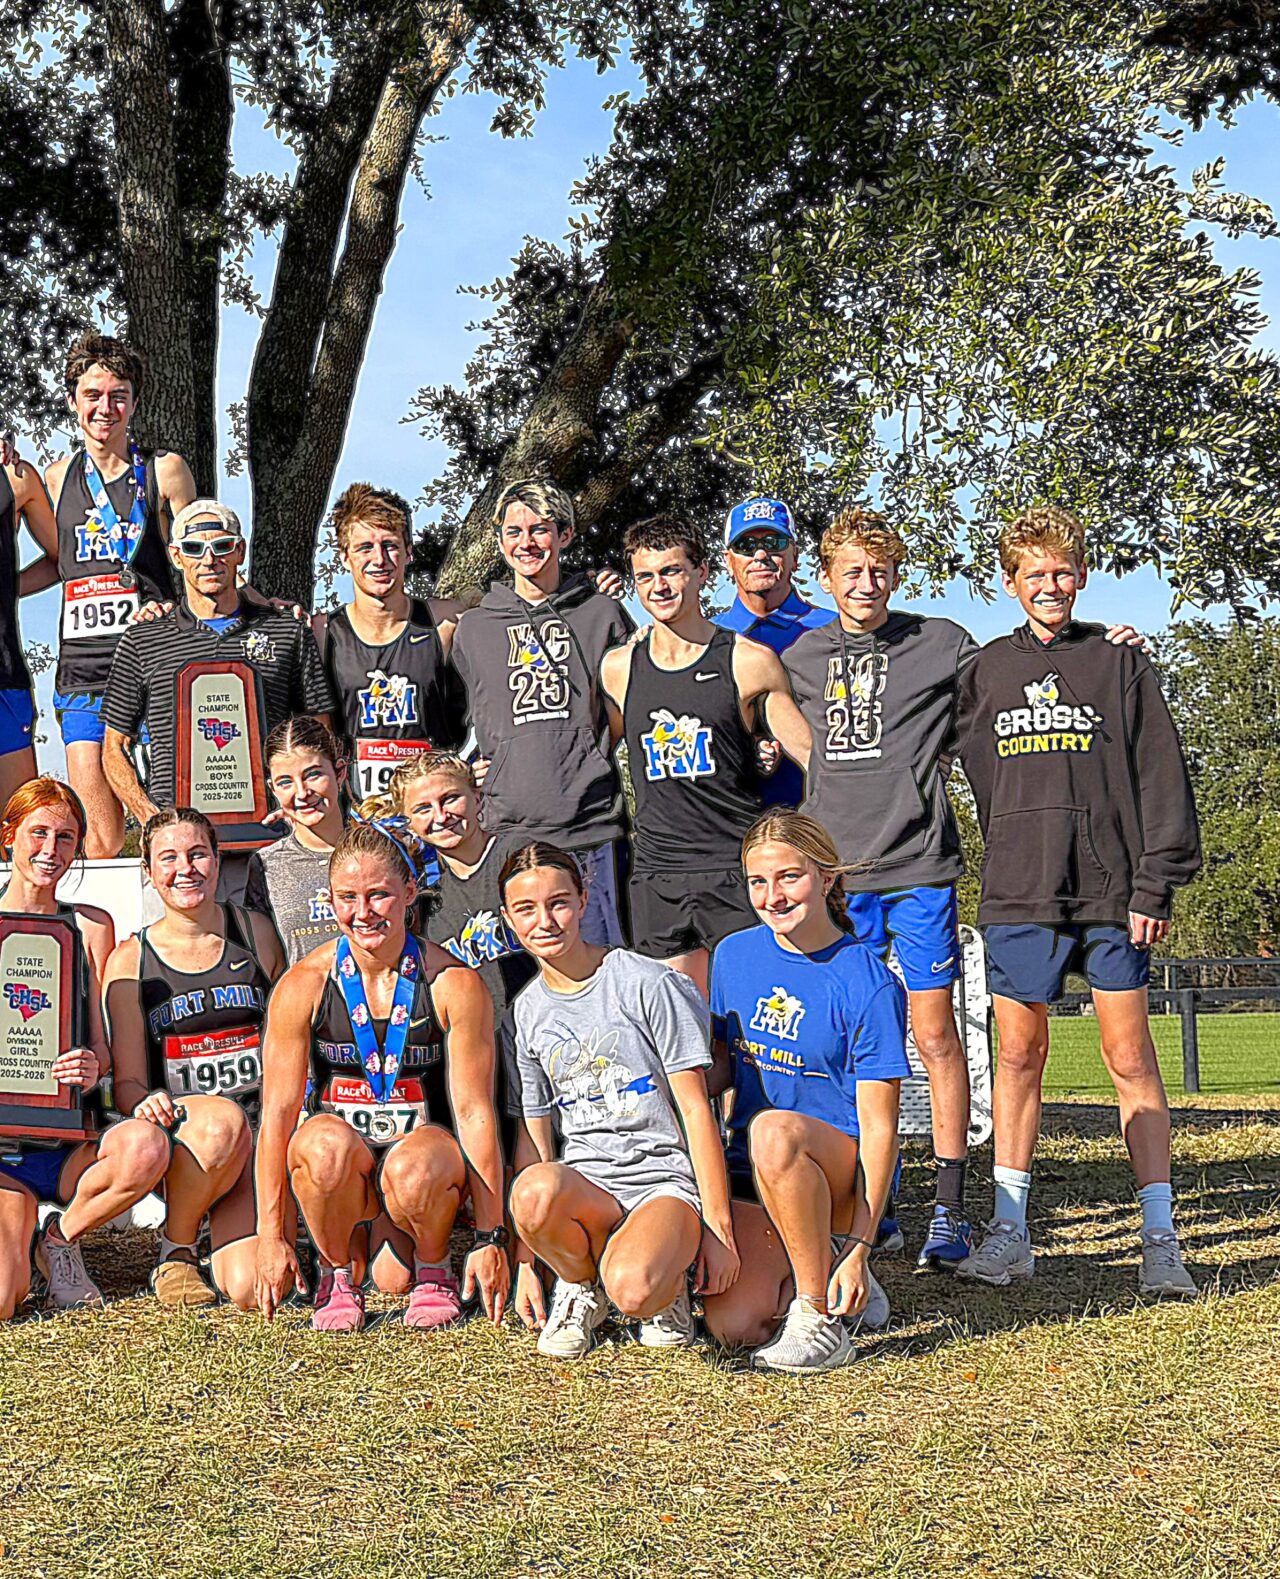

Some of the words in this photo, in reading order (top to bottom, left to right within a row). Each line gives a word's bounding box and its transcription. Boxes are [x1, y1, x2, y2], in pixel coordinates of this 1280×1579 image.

[73, 583, 89, 595] RACE
[97, 580, 120, 593] RESU
[70, 601, 131, 631] 1952
[509, 664, 570, 715] 25
[206, 694, 230, 703] STATE
[198, 703, 239, 714] CHAMPION
[825, 701, 883, 751] 25
[997, 705, 1095, 737] CROSS
[368, 745, 388, 755] RACE
[997, 733, 1094, 757] COUNTRY
[206, 755, 236, 763] AAAAA
[210, 773, 233, 781] BOYS
[361, 766, 394, 793] 19
[195, 783, 218, 791] CROSS
[218, 781, 249, 790] COUNTRY
[202, 791, 243, 801] 2025-2026
[17, 956, 44, 967] STATE
[6, 967, 53, 979] CHAMPION
[149, 989, 205, 1035] FORT
[210, 984, 266, 1013] MILL
[7, 1026, 42, 1037] AAAAA
[6, 1037, 37, 1045] DIVISION
[180, 1041, 204, 1053] RACE
[215, 1035, 246, 1048] RESULT
[9, 1047, 39, 1057] GIRLS
[317, 1040, 359, 1064] FOR
[734, 1038, 767, 1057] FORT
[770, 1047, 805, 1067] MILL
[20, 1058, 54, 1070] COUNTRY
[762, 1063, 796, 1077] COUNTRY
[0, 1068, 46, 1081] 2025-2026
[176, 1053, 258, 1096] 1959
[337, 1085, 360, 1098] RACE
